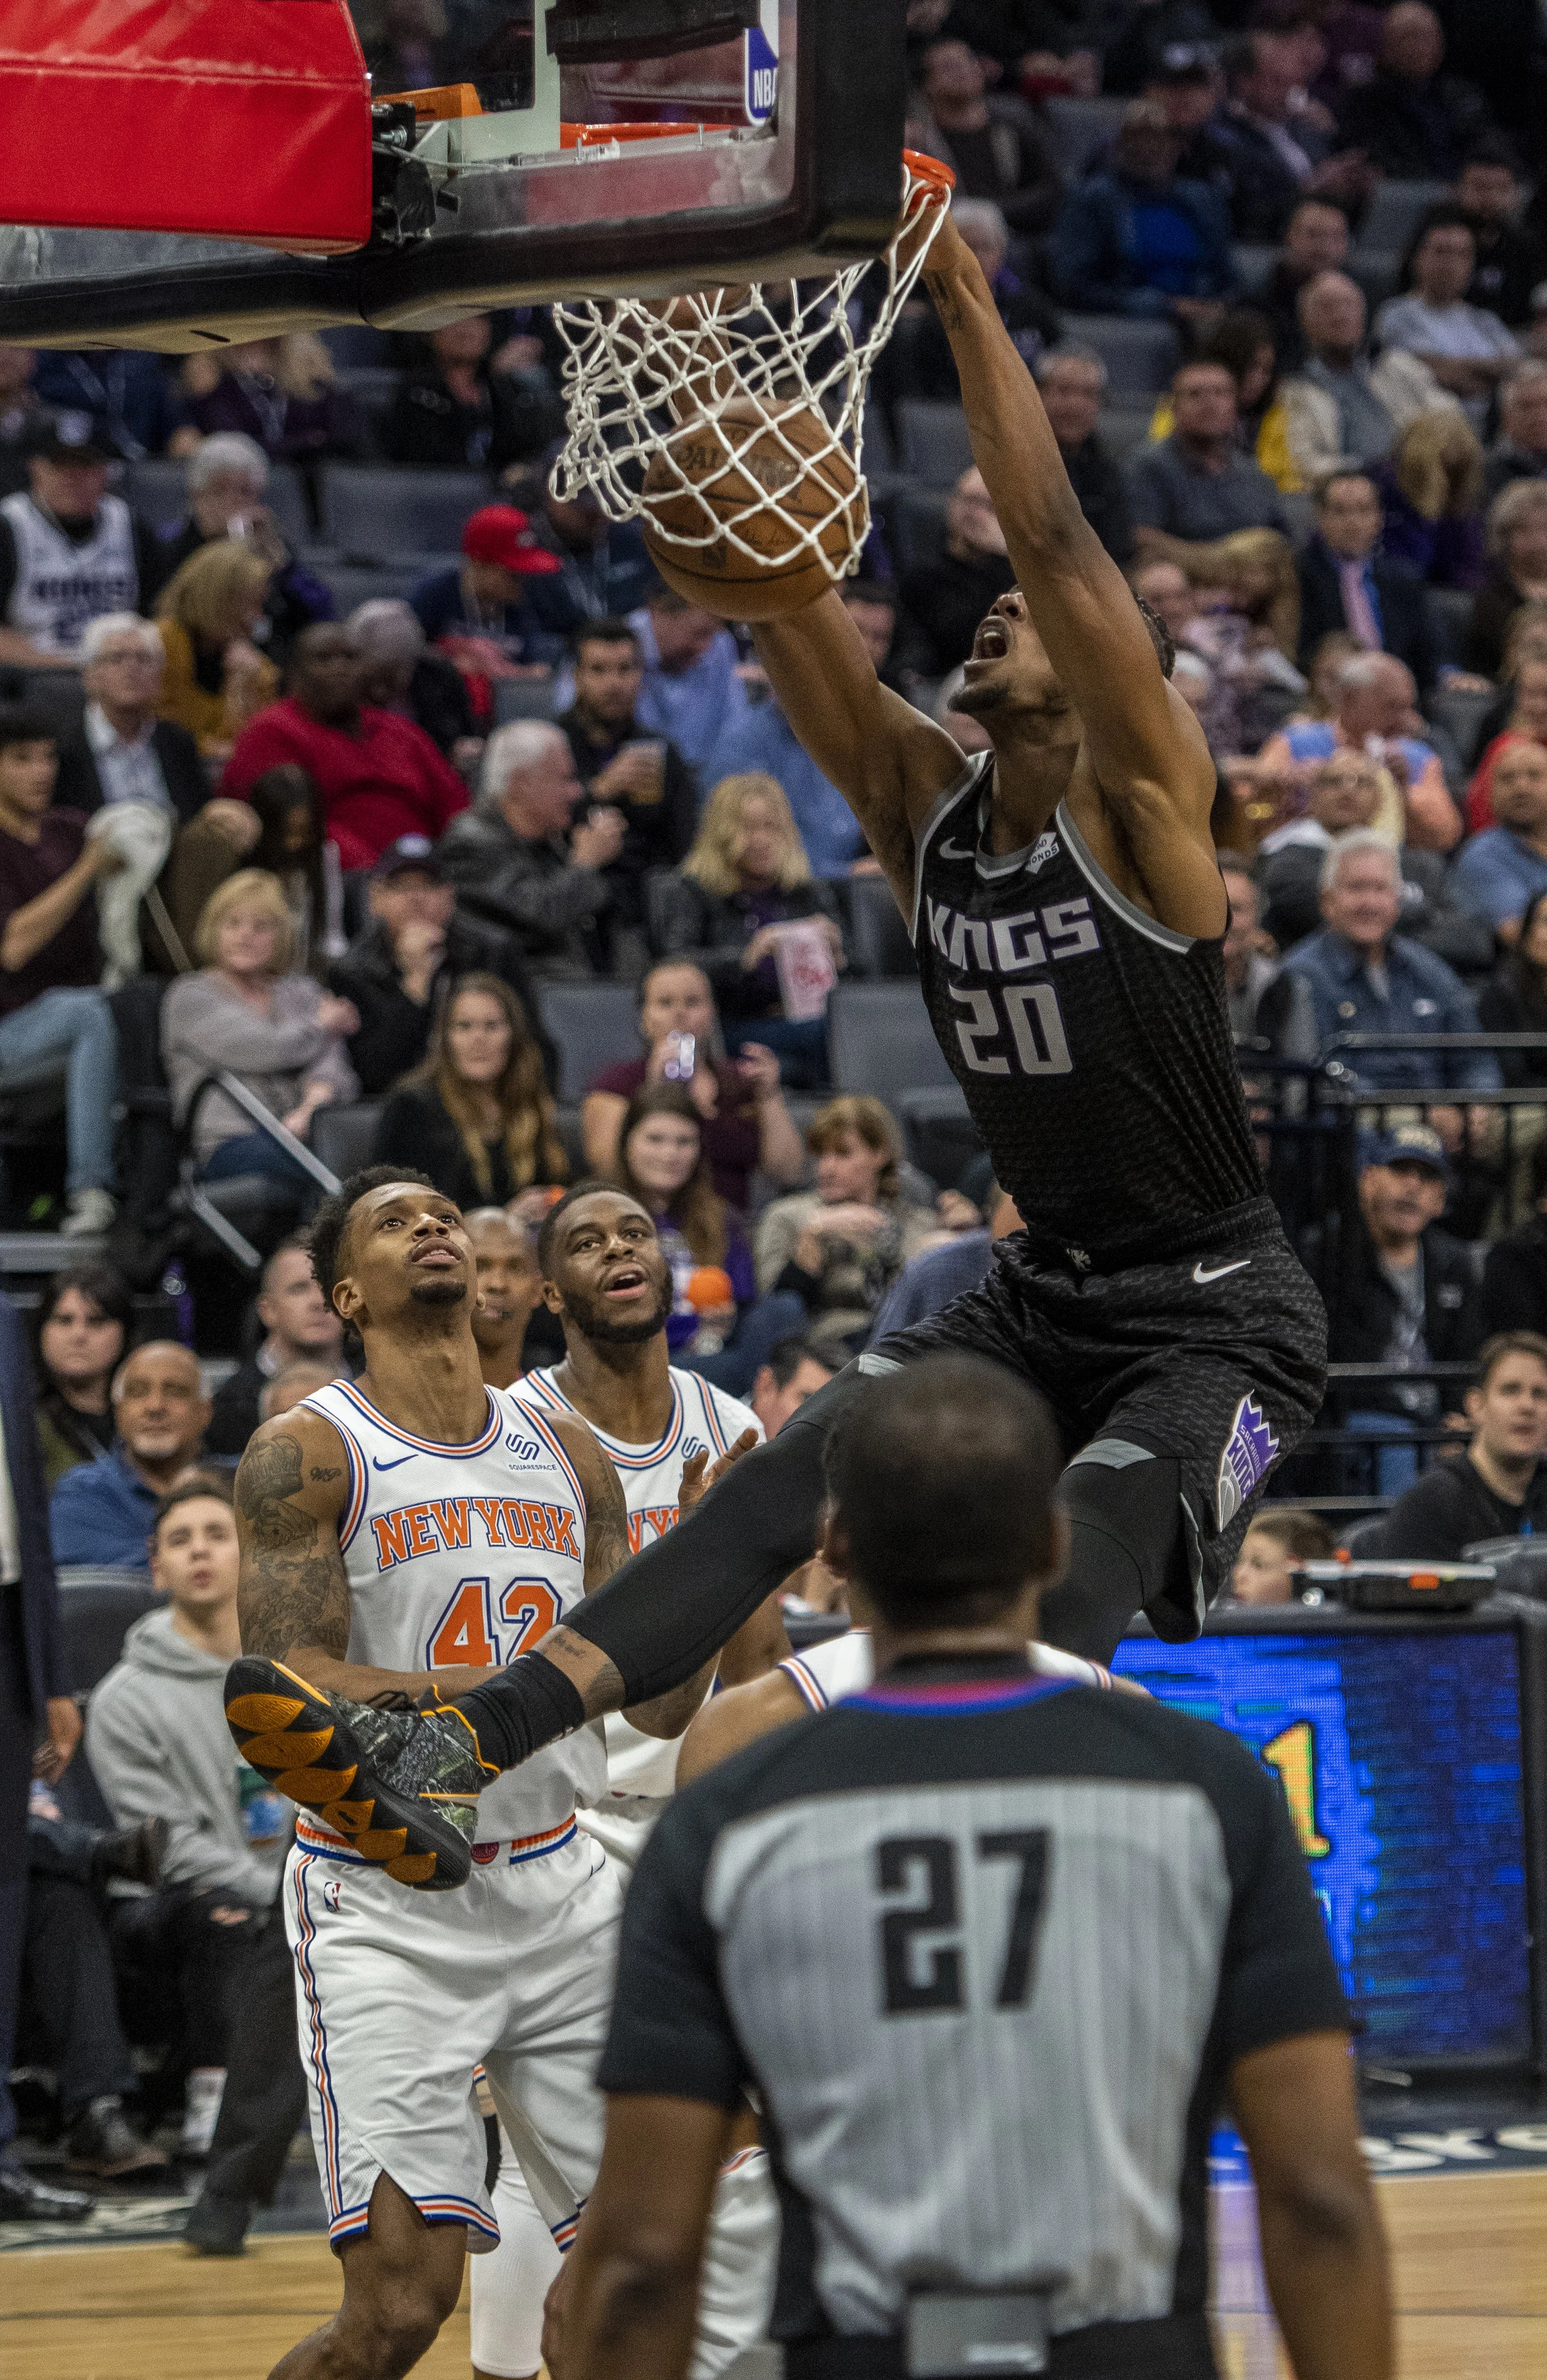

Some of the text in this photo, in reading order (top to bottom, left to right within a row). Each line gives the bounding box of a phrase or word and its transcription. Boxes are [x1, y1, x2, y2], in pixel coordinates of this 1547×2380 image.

[948, 979, 1073, 1075] 20
[371, 1496, 472, 1573] NEW
[472, 1496, 582, 1564] YORK
[426, 1576, 563, 1671] 42
[873, 1824, 1056, 2016] 27
